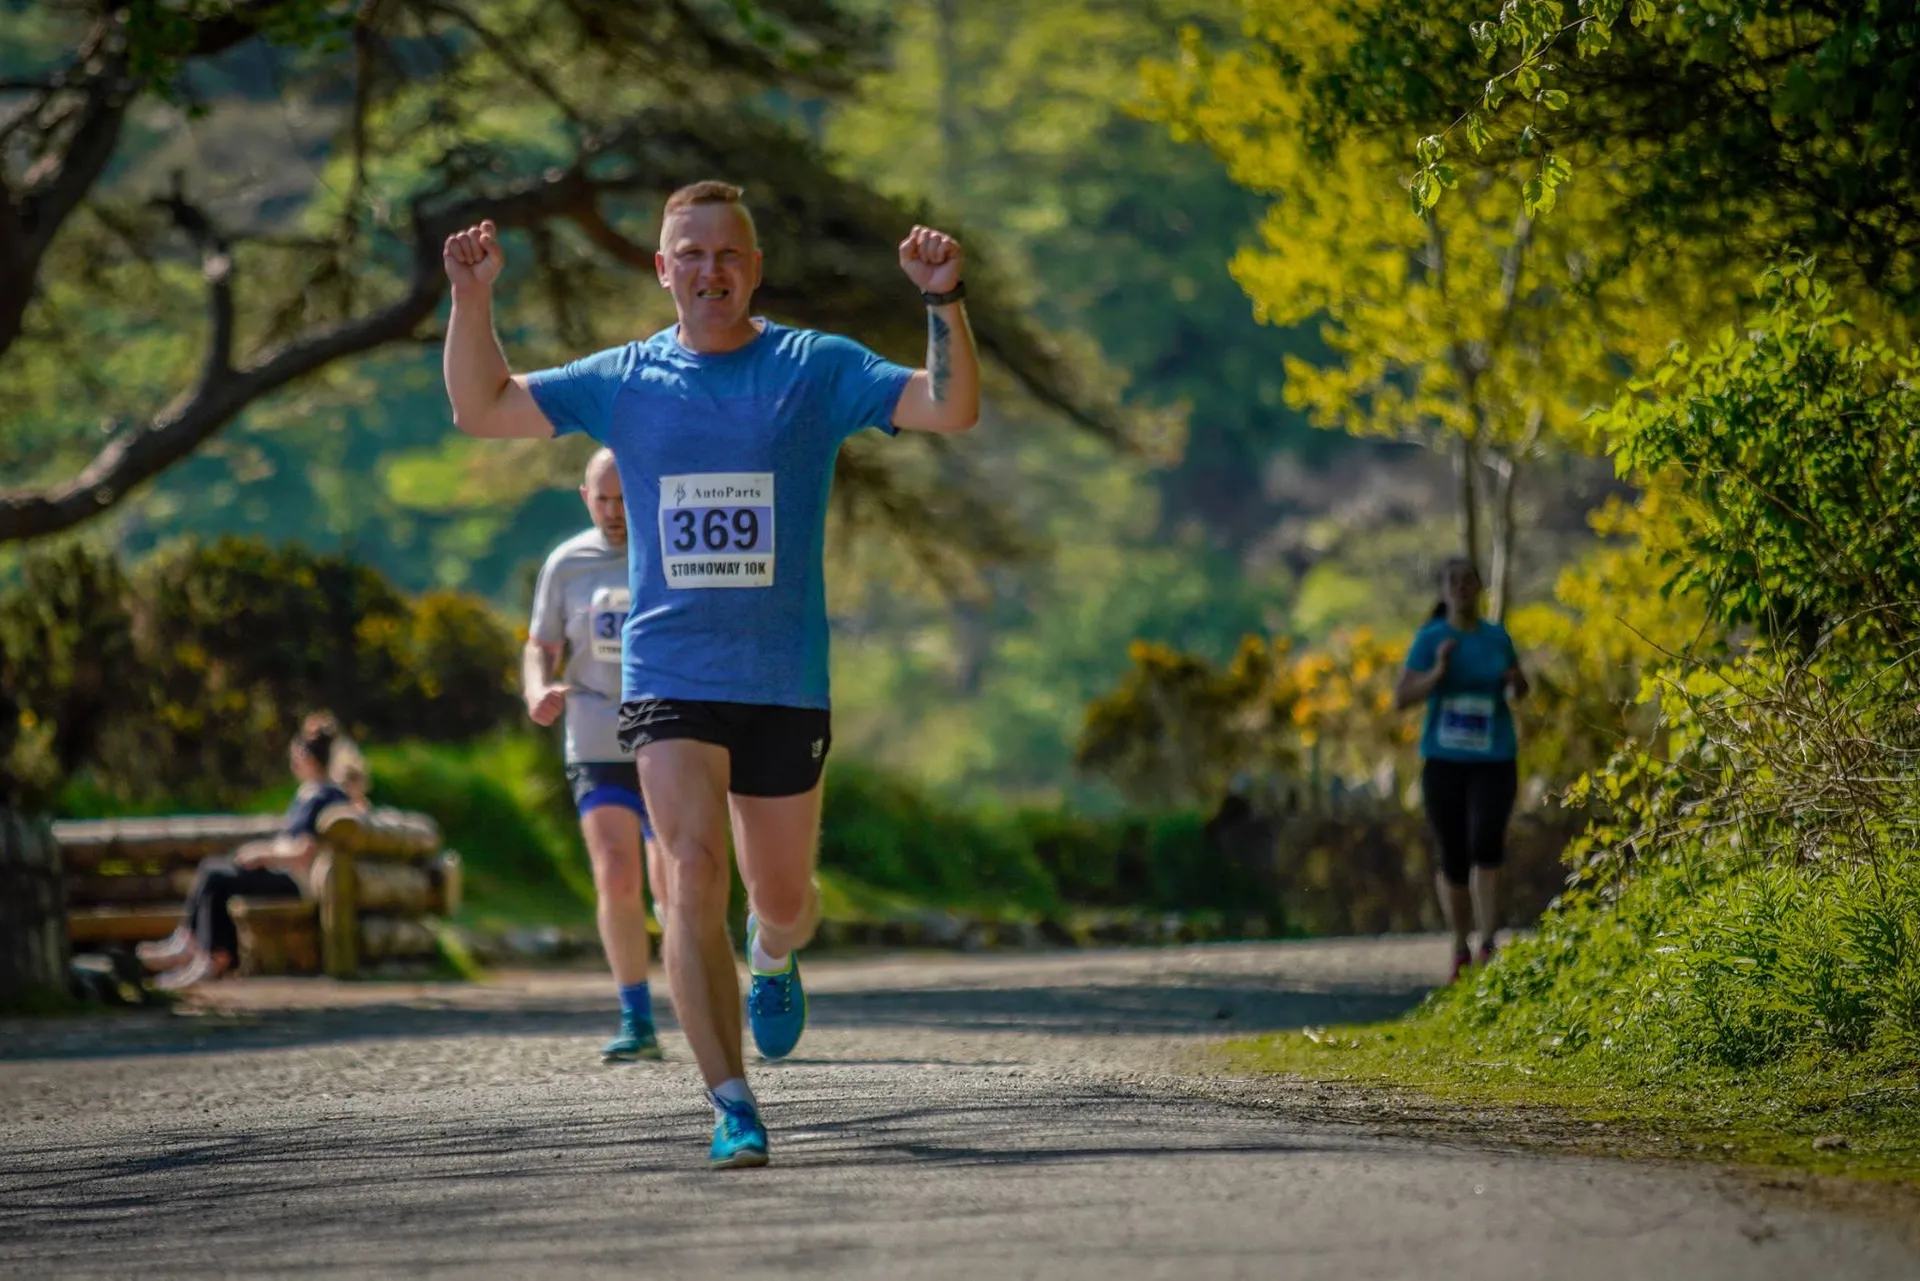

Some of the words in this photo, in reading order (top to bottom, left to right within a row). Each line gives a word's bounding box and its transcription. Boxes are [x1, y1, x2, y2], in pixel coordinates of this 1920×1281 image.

[694, 487, 761, 498] AutoParts
[673, 509, 759, 551] 369
[670, 562, 741, 577] STORNOWAY
[744, 562, 767, 575] 10K
